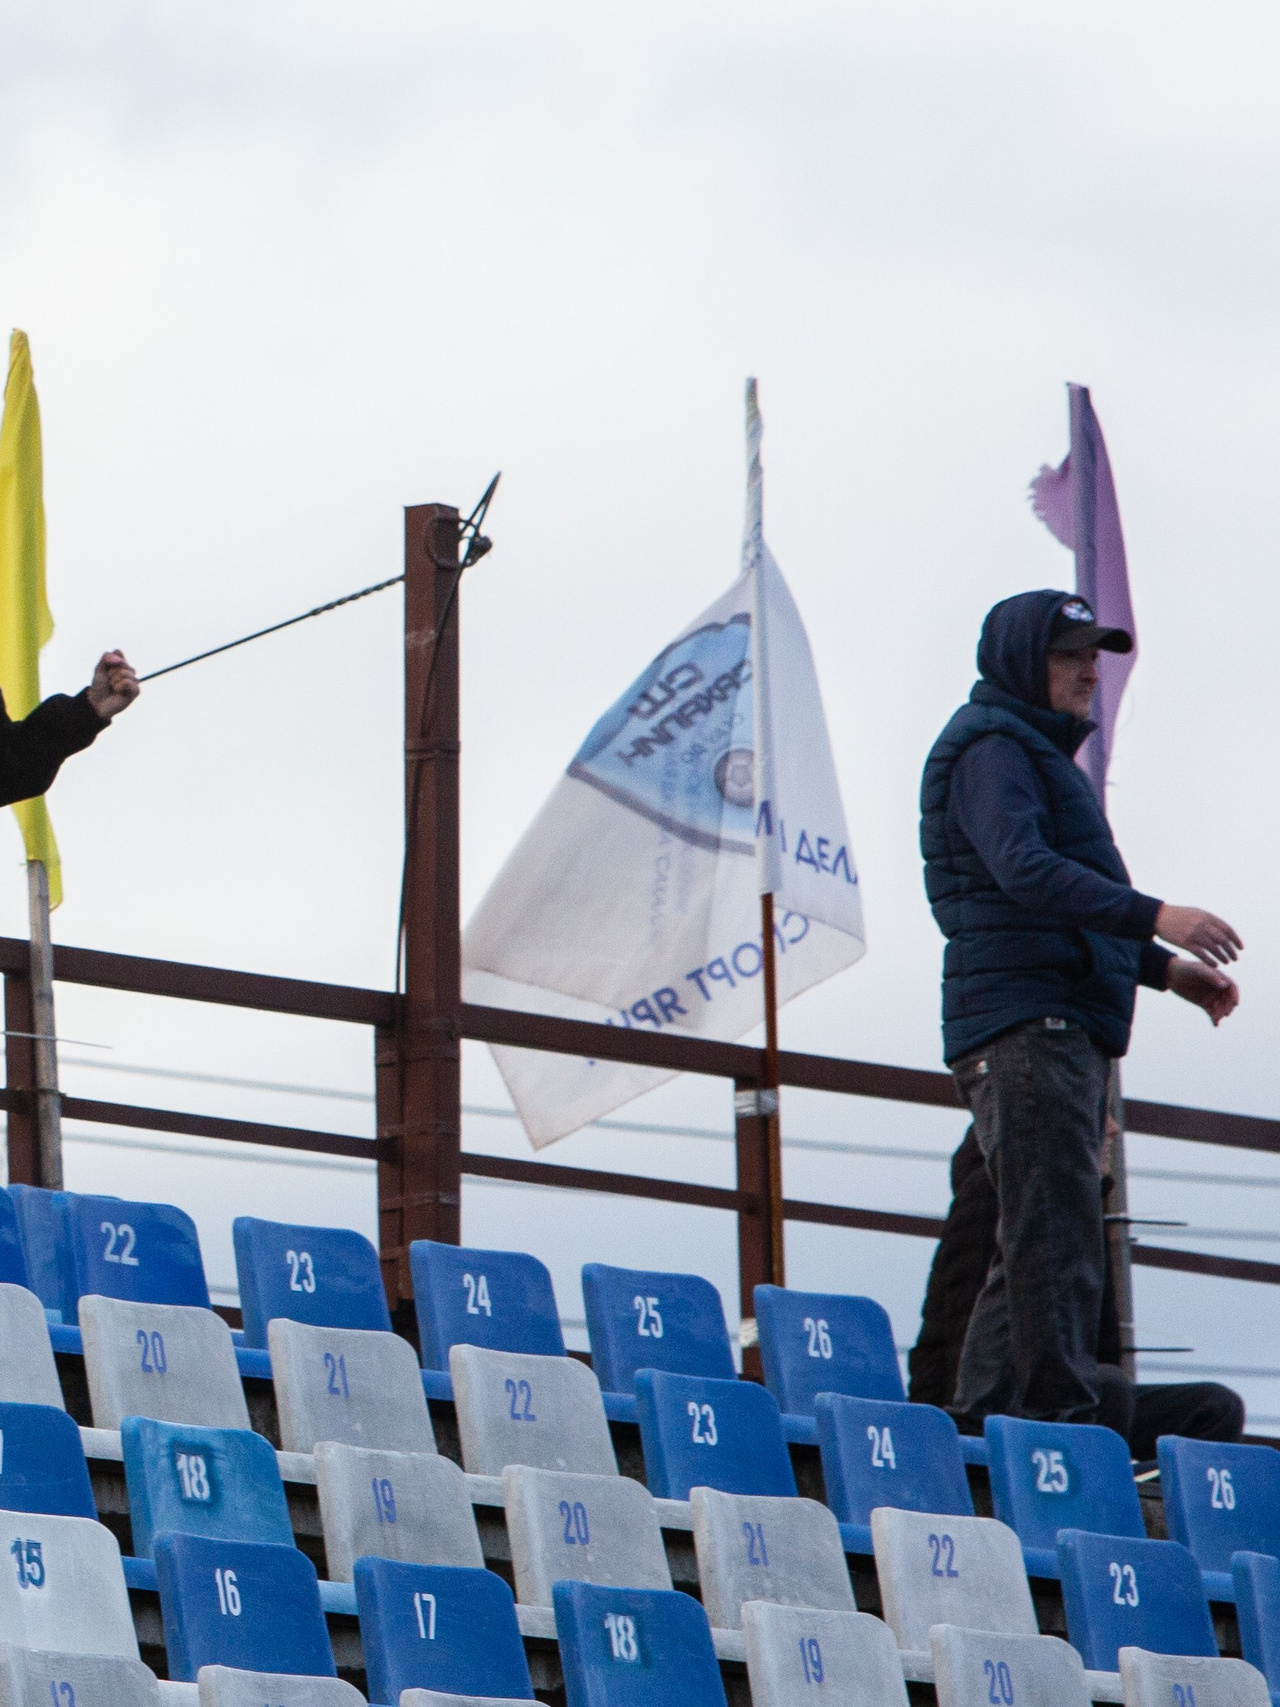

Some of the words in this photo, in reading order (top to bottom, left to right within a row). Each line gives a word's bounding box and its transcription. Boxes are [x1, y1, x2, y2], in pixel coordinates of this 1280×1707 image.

[100, 1221, 138, 1265] 22
[285, 1249, 315, 1293] 23
[462, 1273, 491, 1316] 24
[633, 1295, 662, 1338] 25
[136, 1330, 167, 1378] 20
[803, 1317, 832, 1359] 26
[323, 1352, 349, 1397] 21
[505, 1379, 536, 1422] 22
[687, 1401, 717, 1445] 23
[866, 1425, 895, 1468] 24
[177, 1454, 209, 1499] 18
[1032, 1450, 1068, 1492] 25
[1206, 1467, 1235, 1510] 26
[372, 1478, 397, 1525] 19
[558, 1500, 589, 1545] 20
[11, 1538, 45, 1587] 15
[742, 1522, 769, 1566] 21
[928, 1533, 959, 1578] 22
[215, 1568, 241, 1616] 16
[1109, 1562, 1138, 1607] 23
[414, 1593, 436, 1639] 17
[604, 1613, 638, 1661] 18
[799, 1637, 824, 1684] 19
[984, 1659, 1014, 1707] 20
